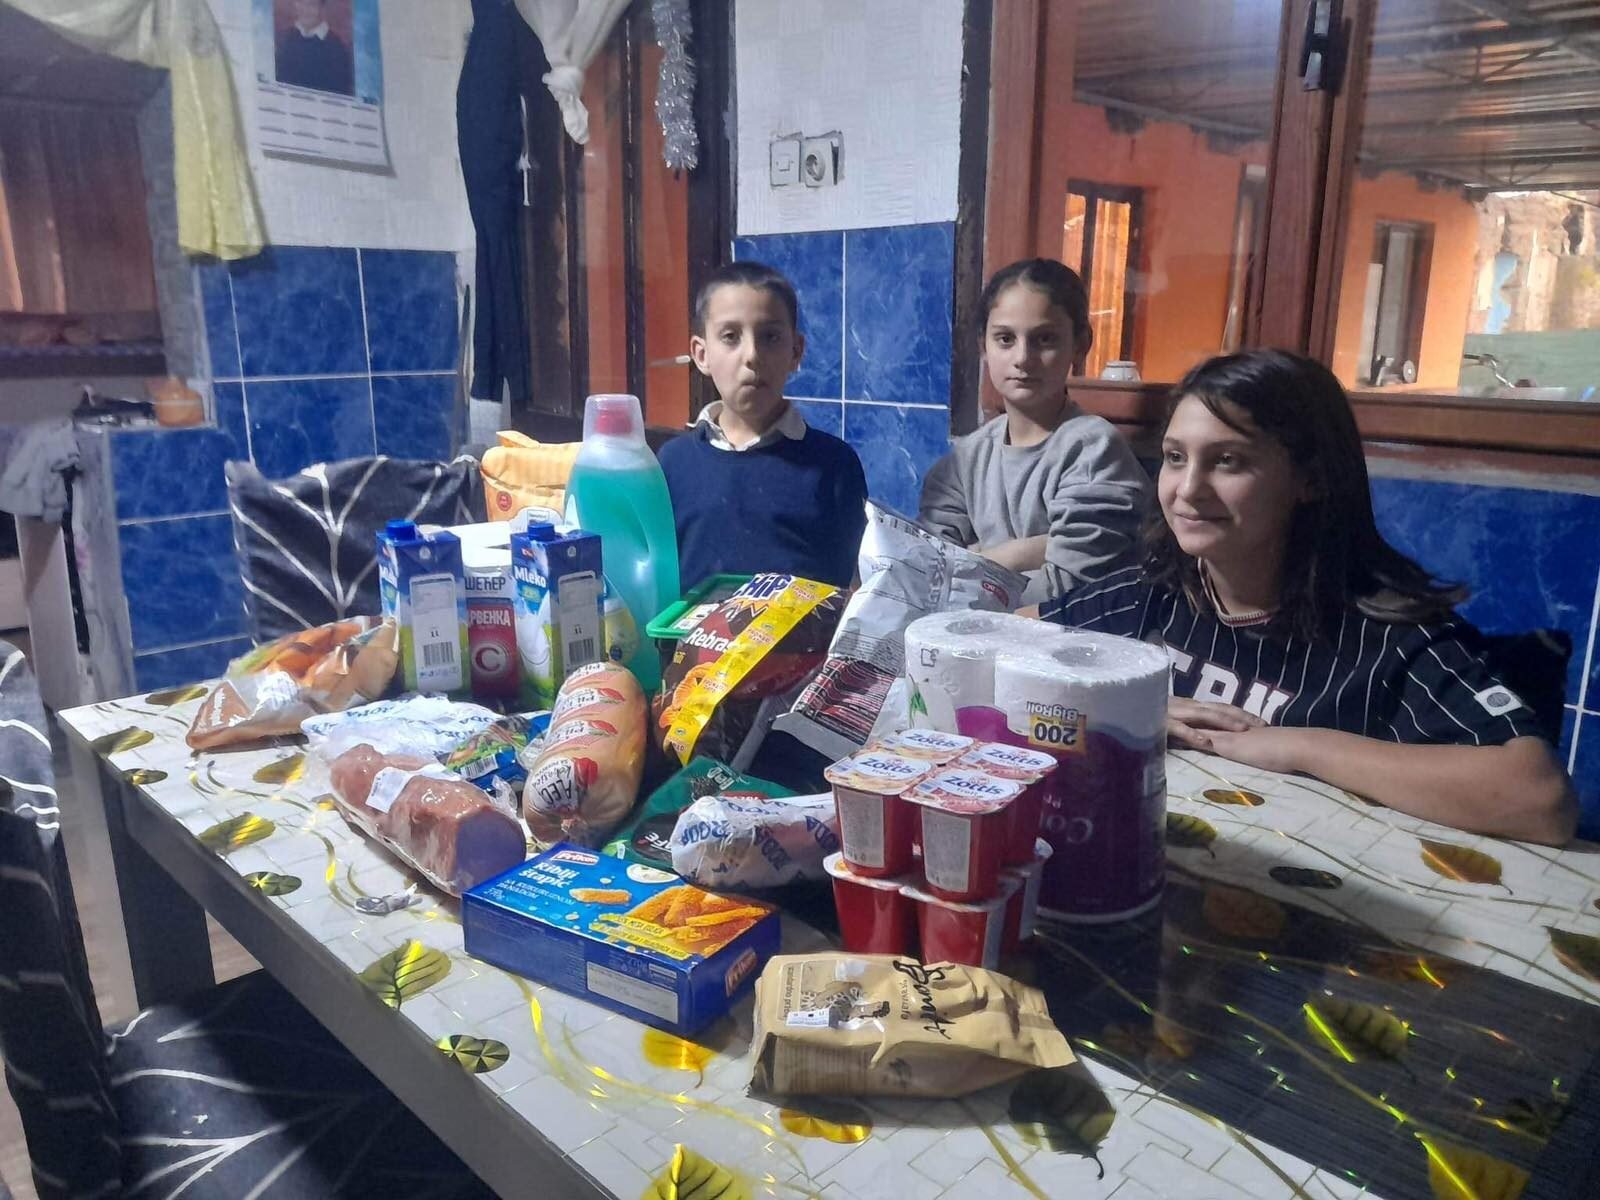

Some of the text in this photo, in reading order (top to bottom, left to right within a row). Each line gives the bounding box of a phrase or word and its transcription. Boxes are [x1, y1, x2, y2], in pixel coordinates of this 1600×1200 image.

[513, 565, 547, 588] Mleko
[469, 609, 511, 627] РВЕНКА
[905, 732, 958, 749] Zottis
[1033, 721, 1078, 746] 200
[859, 757, 917, 775] Zottis
[985, 748, 1044, 767] Zottis
[943, 775, 1004, 796] Zottis
[533, 861, 580, 880] Riblji
